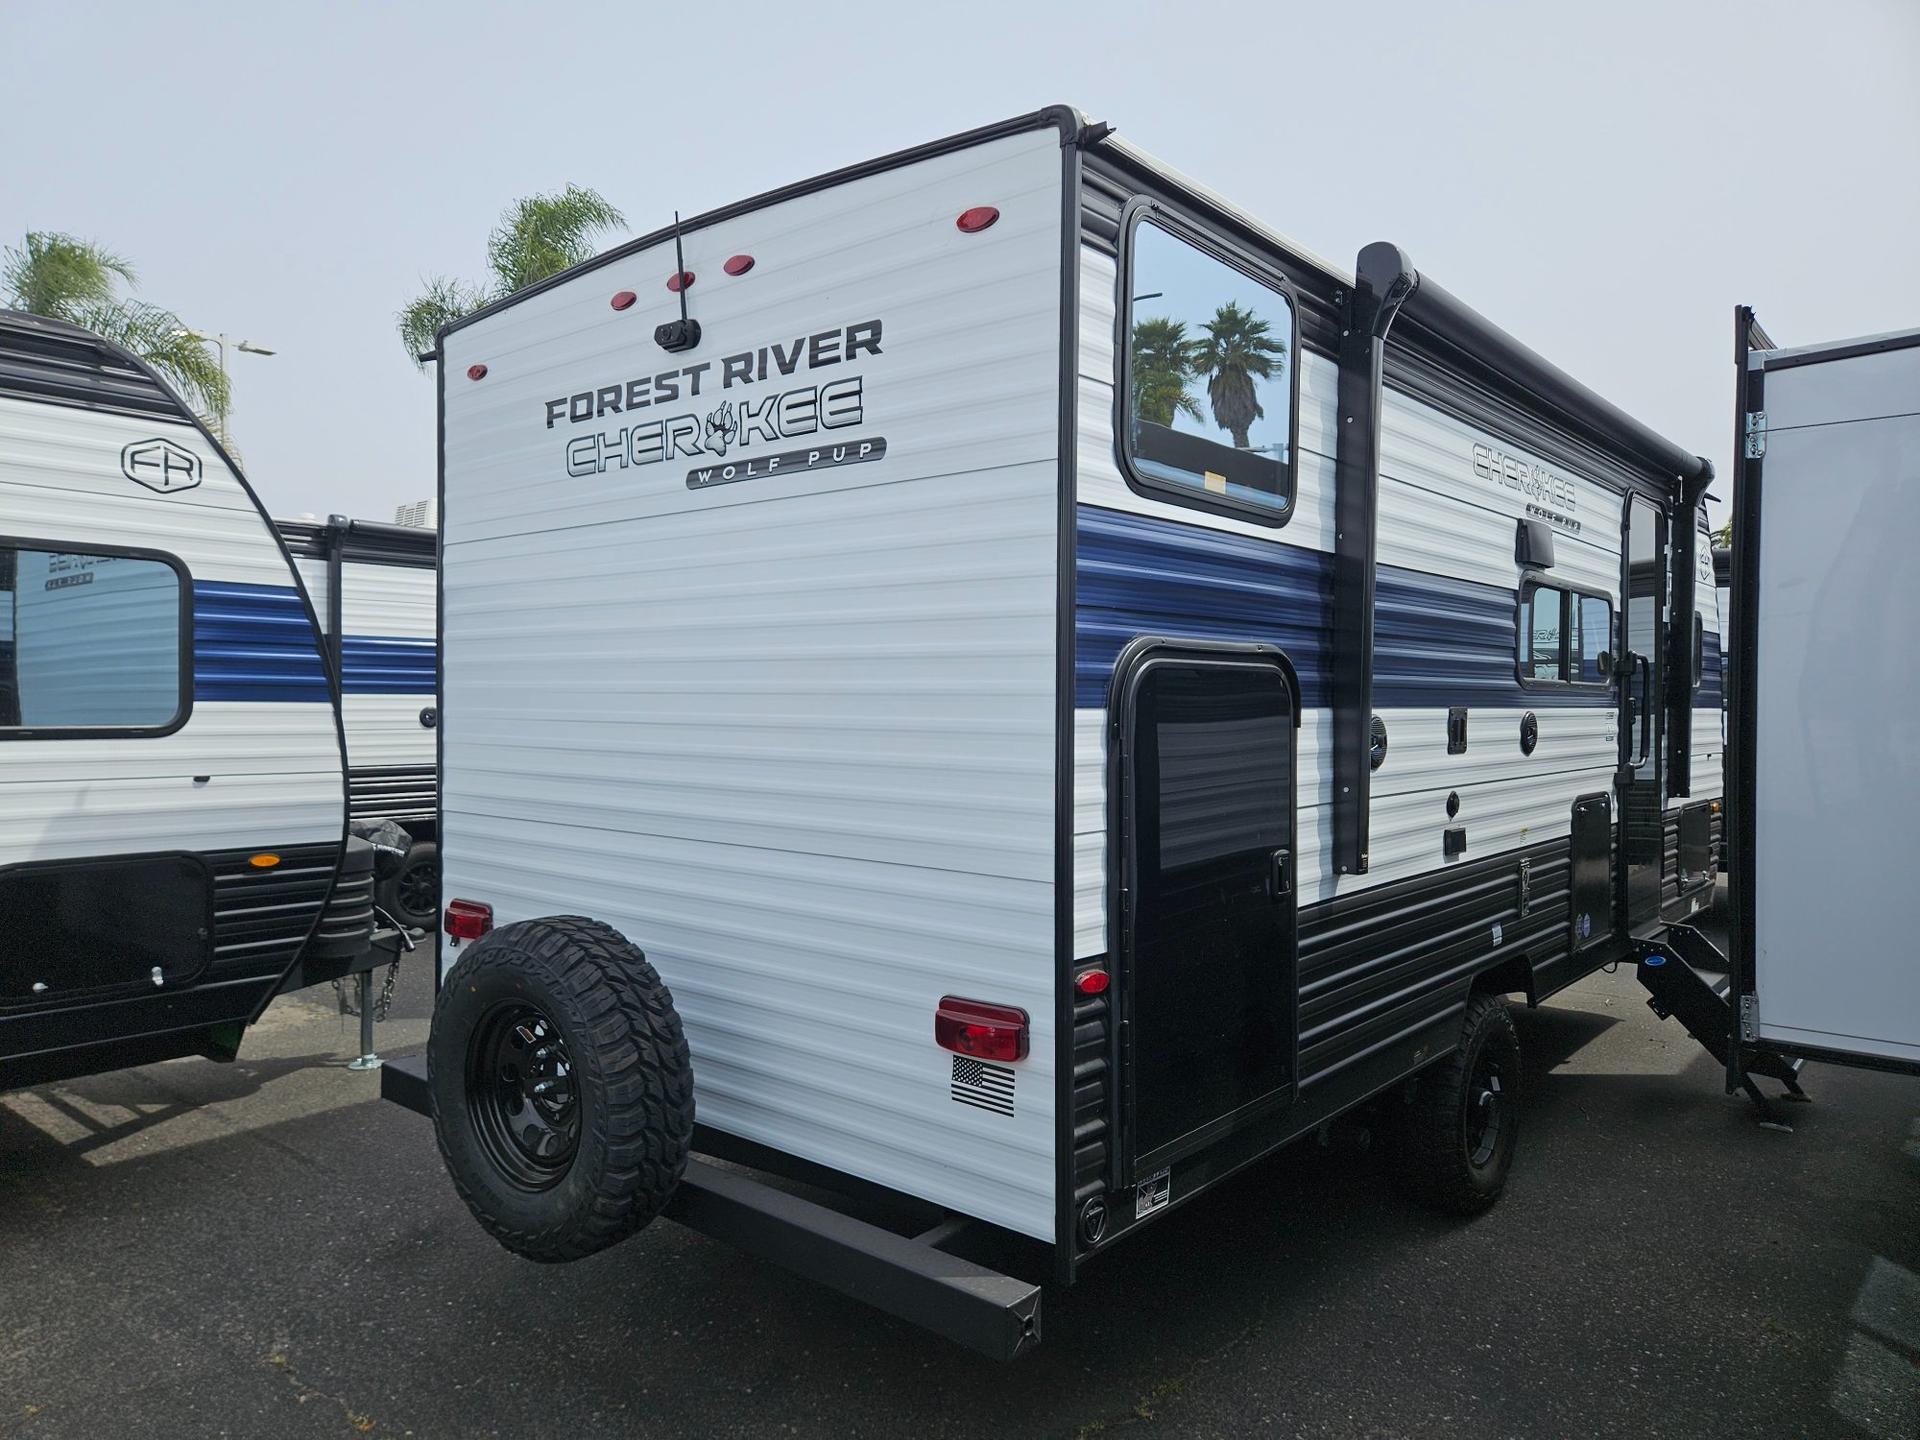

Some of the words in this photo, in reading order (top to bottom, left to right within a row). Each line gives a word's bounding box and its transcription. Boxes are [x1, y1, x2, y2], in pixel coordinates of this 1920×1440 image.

[545, 362, 711, 429] FOREST
[721, 319, 883, 389] RIVER
[566, 375, 863, 478] CHEROKEE
[698, 457, 780, 484] WOLF
[808, 442, 873, 467] PUP
